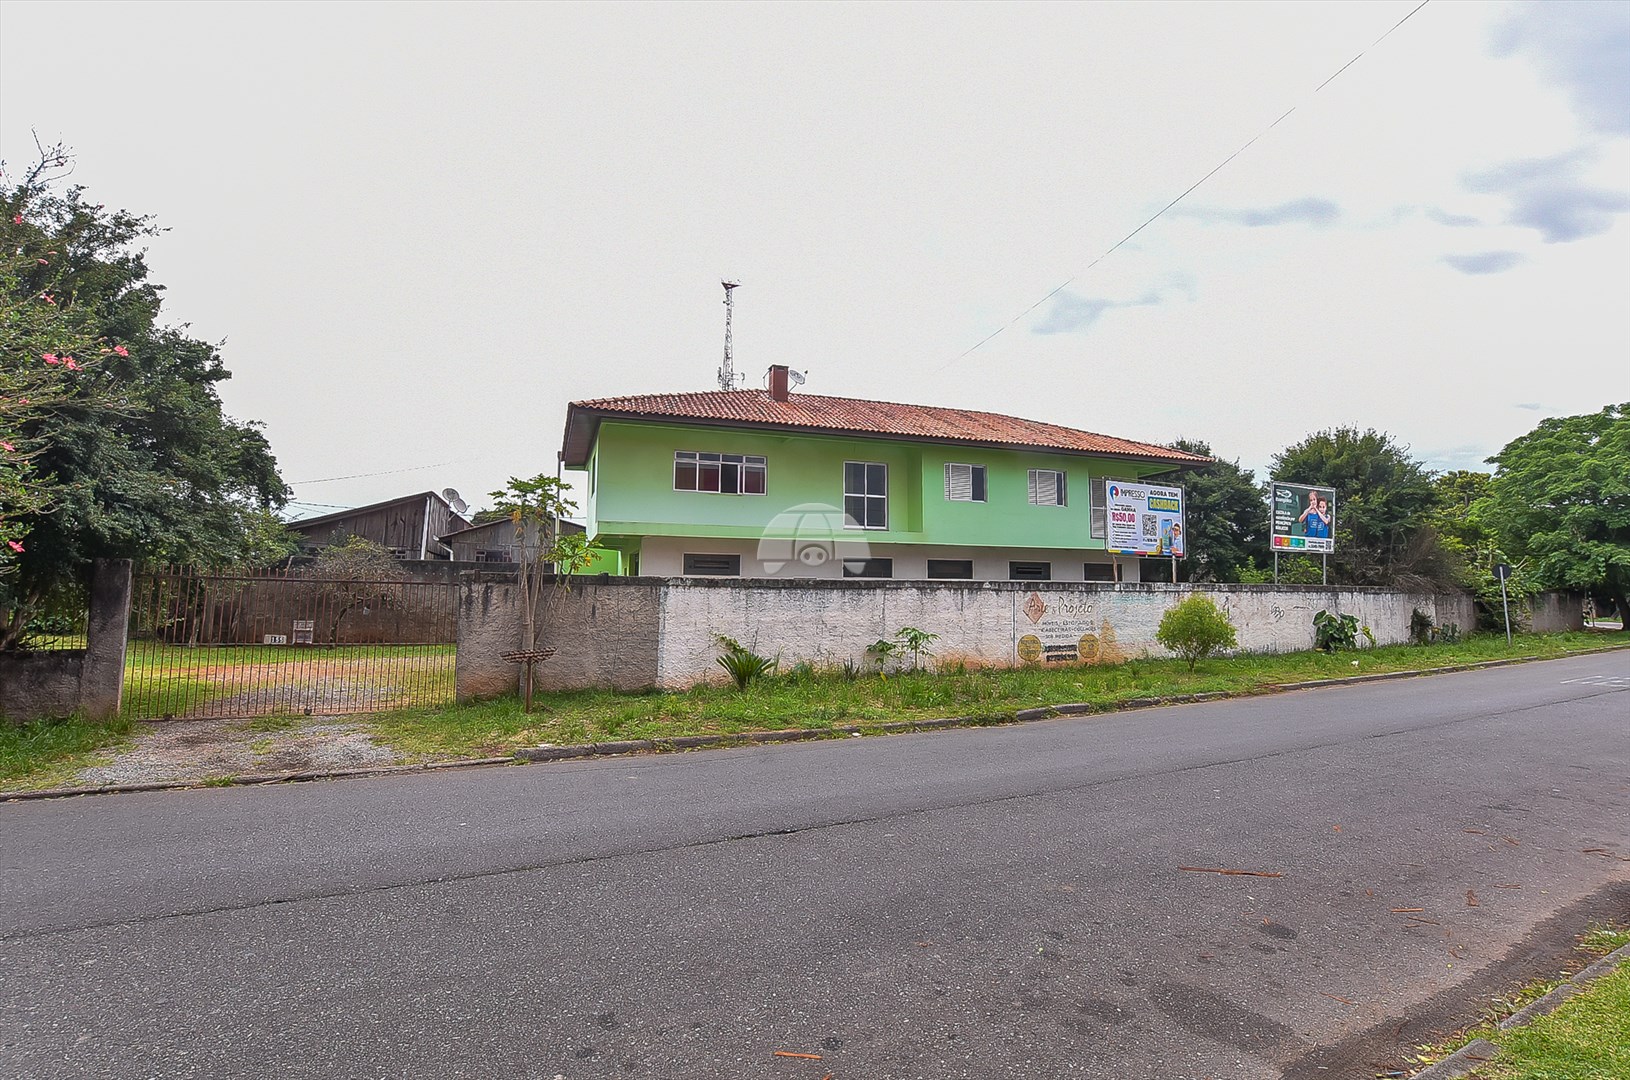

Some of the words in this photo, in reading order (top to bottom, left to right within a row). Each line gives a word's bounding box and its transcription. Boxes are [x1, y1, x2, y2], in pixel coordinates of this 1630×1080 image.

[1120, 488, 1146, 498] IMPRESSO
[1149, 489, 1167, 497] AGORA
[1149, 499, 1179, 510] CASHBACK
[1111, 512, 1136, 523] R$50,00
[1058, 596, 1093, 618] Projeto
